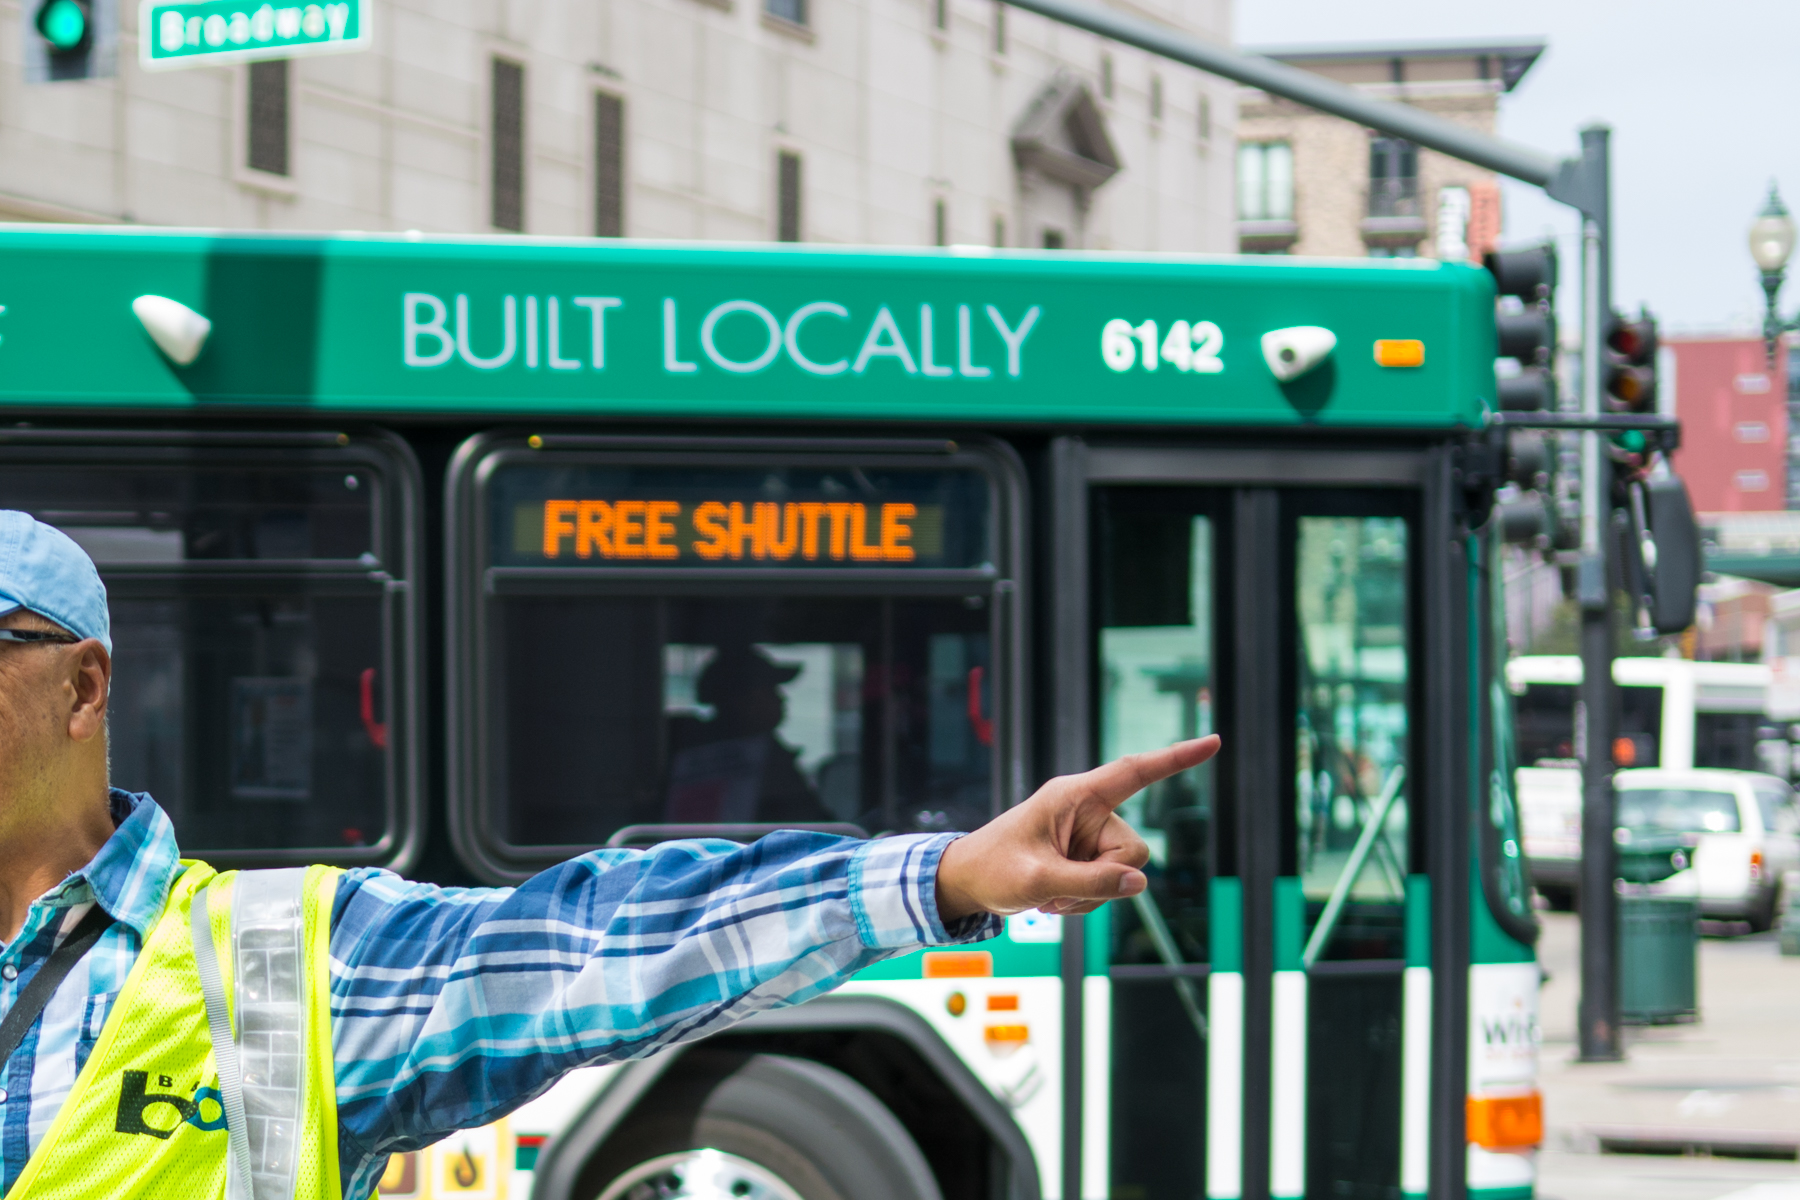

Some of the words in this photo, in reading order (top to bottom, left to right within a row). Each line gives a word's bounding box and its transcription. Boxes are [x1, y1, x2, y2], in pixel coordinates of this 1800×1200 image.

[159, 3, 349, 52] Broadway
[403, 292, 623, 369] BUILT
[663, 298, 1041, 377] LOCALLY
[1101, 318, 1224, 373] 6142
[544, 500, 680, 559] FREE
[693, 502, 916, 561] SHUTTLE
